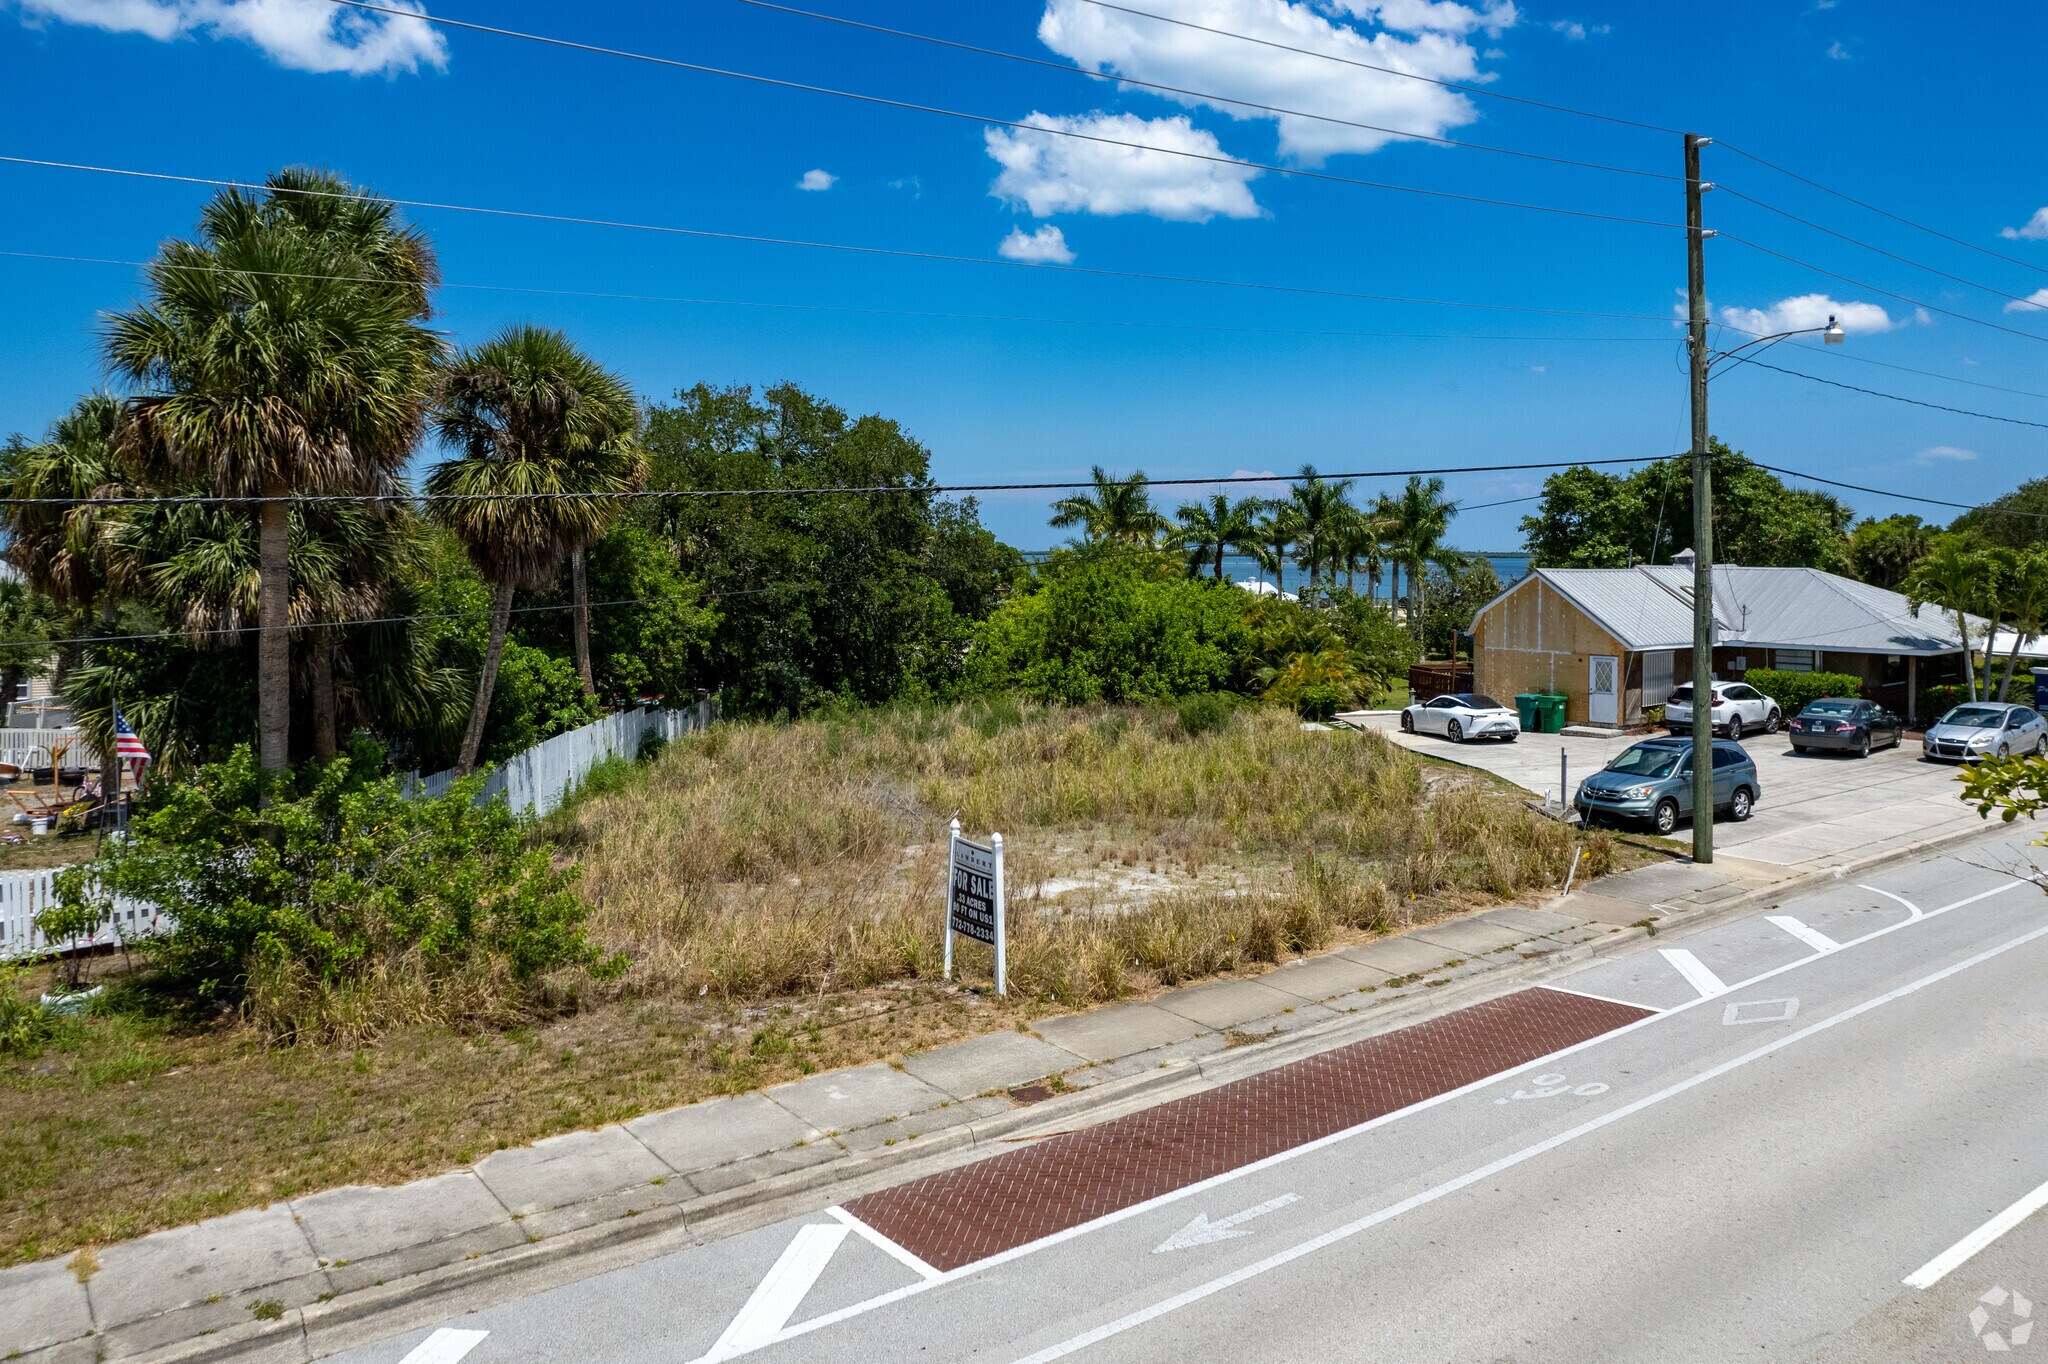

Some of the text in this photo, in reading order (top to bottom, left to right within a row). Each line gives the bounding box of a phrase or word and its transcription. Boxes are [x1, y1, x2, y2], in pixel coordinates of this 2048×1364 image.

[956, 851, 993, 869] LAMBERT
[954, 868, 993, 900] FOR SALE
[966, 896, 987, 911] ACRES
[961, 904, 968, 916] FT
[968, 908, 978, 920] ON
[979, 913, 994, 925] US1
